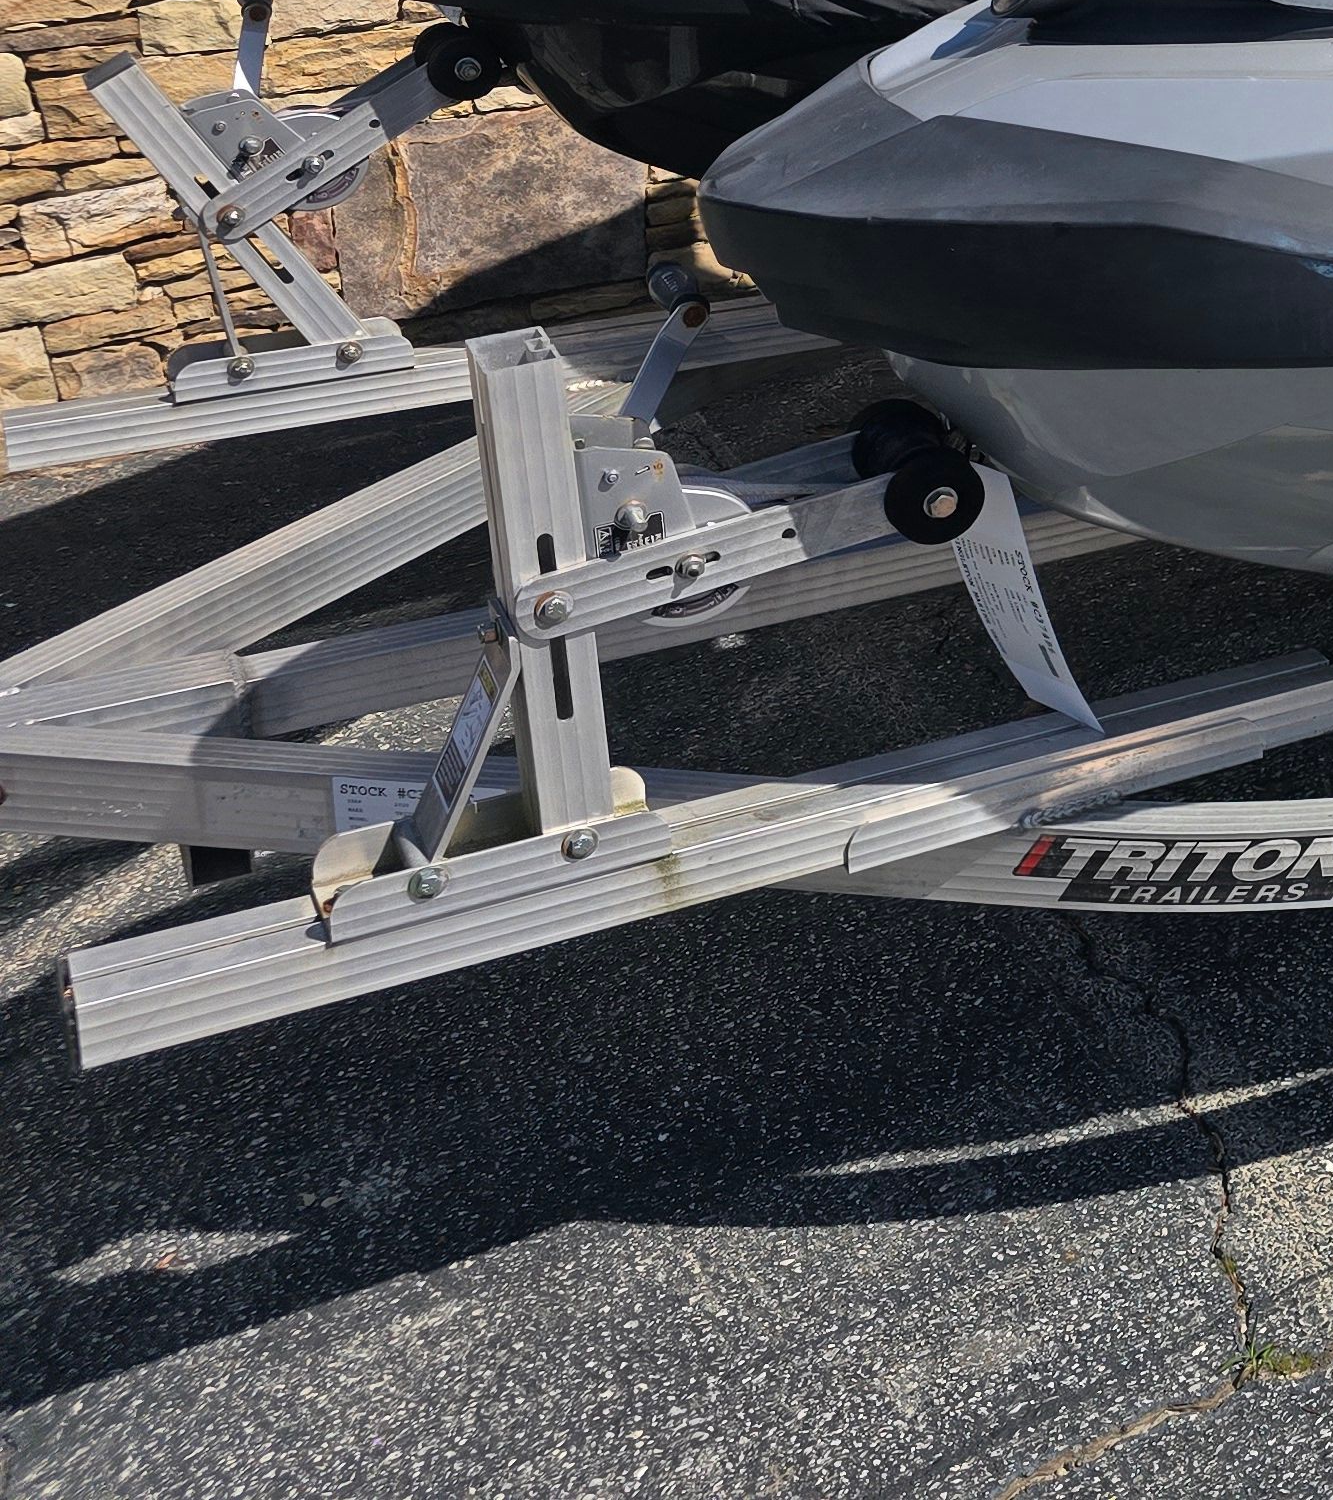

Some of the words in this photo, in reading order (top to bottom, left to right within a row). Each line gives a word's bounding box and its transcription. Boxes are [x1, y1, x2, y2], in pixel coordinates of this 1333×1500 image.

[1015, 550, 1034, 594] STOCK
[340, 783, 387, 797] STOCK
[1108, 882, 1310, 905] TRAILERS
